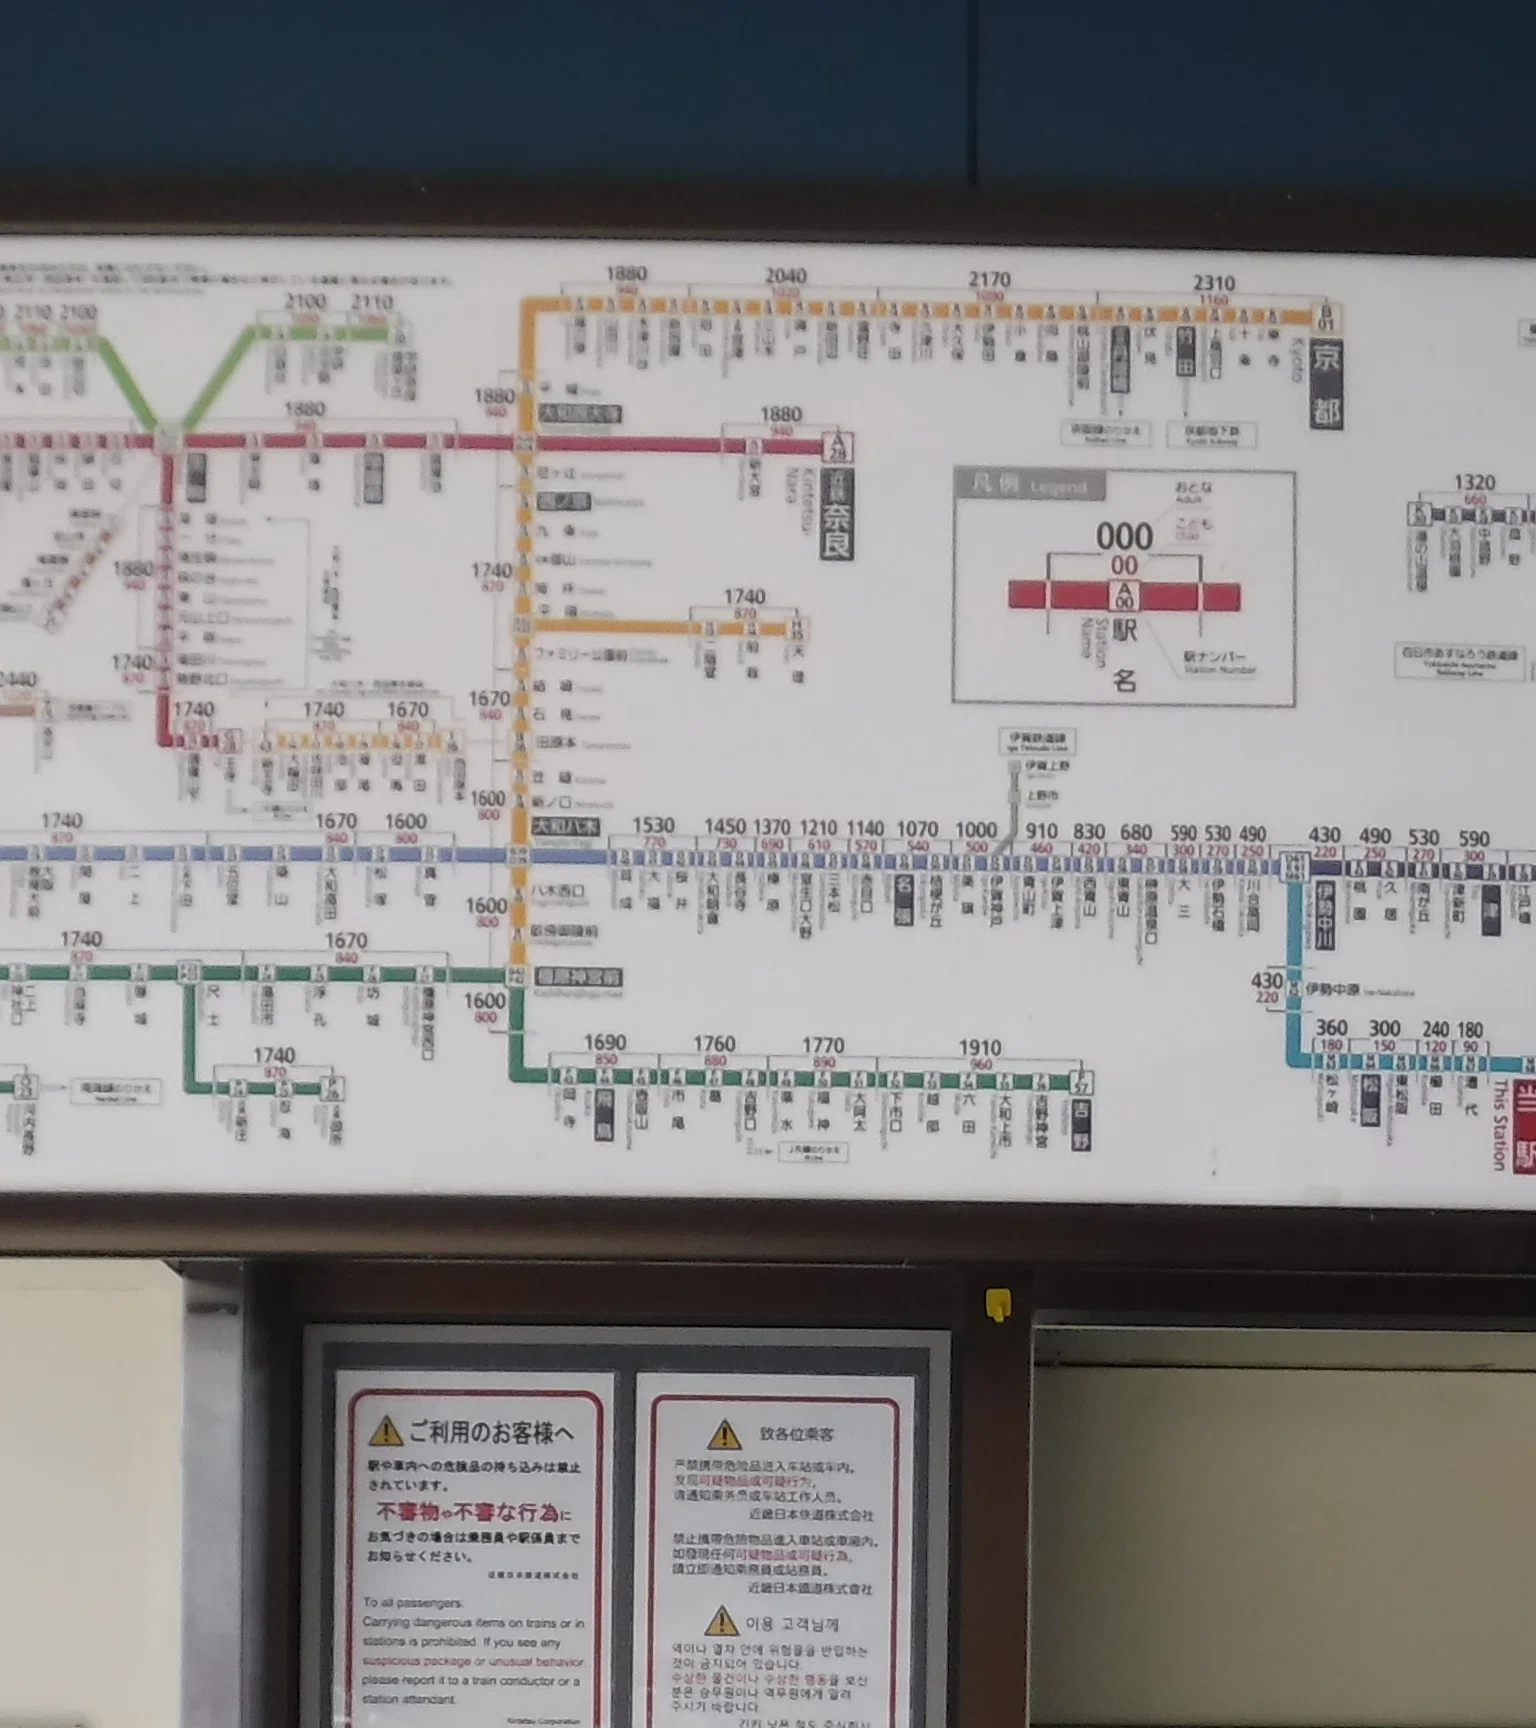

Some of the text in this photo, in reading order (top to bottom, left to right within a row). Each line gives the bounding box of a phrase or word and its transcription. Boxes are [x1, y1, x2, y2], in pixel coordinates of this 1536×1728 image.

[765, 268, 807, 284] 2040
[1194, 275, 1235, 292] 2310
[1314, 346, 1340, 426] 京都
[1097, 521, 1153, 550] 000
[1112, 555, 1137, 574] 00
[725, 589, 765, 604] 1740
[1118, 583, 1131, 595] A
[1116, 597, 1134, 608] 00
[1082, 618, 1091, 659] Name
[1096, 618, 1105, 668] Station
[1113, 618, 1137, 692] 駅名
[470, 691, 510, 707] 1670
[317, 813, 357, 829] 1670
[634, 817, 674, 833] 1530
[754, 819, 790, 835] 1370
[898, 822, 938, 837] 1070
[956, 822, 997, 838] 1000
[1074, 824, 1105, 840] 830
[1171, 826, 1197, 841] 590
[1240, 826, 1266, 842] 490
[1309, 827, 1340, 843] 430
[1409, 830, 1440, 846] 530
[1460, 830, 1490, 847] 590
[61, 931, 102, 948] 1740
[326, 933, 367, 949] 1670
[1306, 982, 1360, 996] 伊勢中原
[465, 993, 505, 1009] 1600
[1370, 1020, 1401, 1037] 300
[1459, 1022, 1483, 1038] 180
[586, 1034, 626, 1050] 1690
[803, 1037, 844, 1053] 1770
[960, 1039, 1002, 1056] 1910
[1322, 1040, 1342, 1050] 180
[1374, 1040, 1395, 1050] 150
[1494, 1080, 1508, 1172] This Station
[411, 1419, 574, 1445] ご利用のお客様へ
[369, 1481, 448, 1492] されています。
[377, 1502, 572, 1522] 不審物や不審な行為に
[368, 1551, 472, 1563] お知らせください。
[365, 1597, 393, 1607] To all
[363, 1617, 409, 1629] Carrying
[414, 1617, 472, 1629] dangerous
[476, 1619, 505, 1628] items
[509, 1620, 522, 1628] on
[527, 1620, 556, 1628] trains
[575, 1620, 584, 1628] in
[747, 1618, 773, 1632] 이용
[363, 1638, 405, 1646] stations
[494, 1640, 513, 1649] you
[518, 1639, 537, 1647] see
[541, 1640, 560, 1650] any
[363, 1658, 420, 1667] suspicious
[424, 1658, 471, 1669] package
[489, 1658, 532, 1666] unusual
[362, 1677, 398, 1686] please
[402, 1677, 435, 1686] report
[473, 1677, 496, 1685] train
[500, 1677, 554, 1686] conductor
[363, 1696, 398, 1704] station
